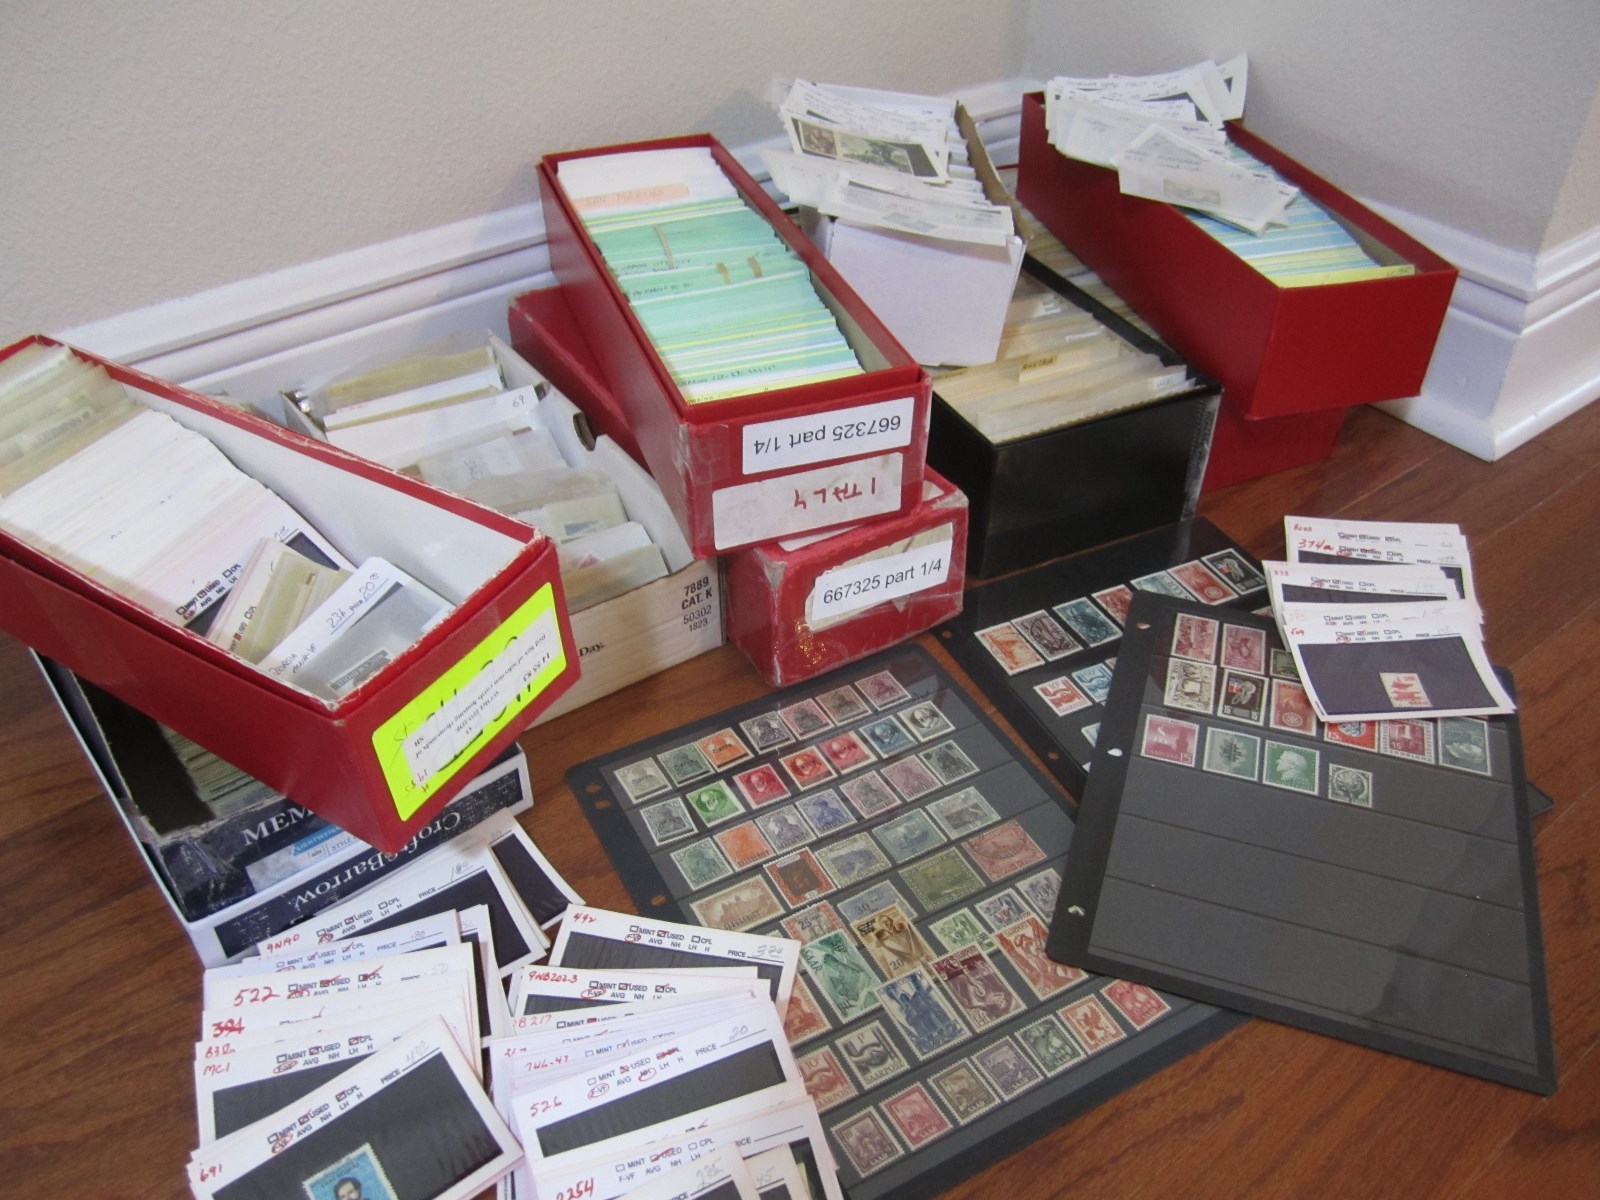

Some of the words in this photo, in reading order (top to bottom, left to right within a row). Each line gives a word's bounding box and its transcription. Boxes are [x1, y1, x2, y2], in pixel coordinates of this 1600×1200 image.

[788, 428, 826, 448] part
[832, 415, 901, 442] 667325
[753, 435, 782, 455] 1/4
[683, 576, 709, 596] 7889
[823, 574, 881, 604] 667325
[885, 566, 916, 590] part
[921, 558, 943, 577] 1/4
[681, 594, 703, 610] CAT.
[705, 587, 713, 599] K
[683, 605, 712, 625] 50302
[341, 924, 356, 935] AVG
[363, 916, 374, 925] NH
[418, 886, 437, 899] PRICE
[854, 902, 871, 915] 30
[326, 921, 344, 934] MINT
[354, 909, 373, 921] USED
[376, 941, 397, 951] PRICE
[639, 926, 656, 936] MINT
[666, 931, 685, 941] USED
[700, 937, 713, 946] CPL
[317, 949, 337, 959] USED
[648, 937, 664, 946] AVG
[670, 941, 682, 949] NH
[688, 943, 698, 951] LH
[704, 945, 711, 953] H
[727, 949, 747, 958] PRICE
[298, 982, 318, 991] MINT
[331, 977, 351, 986] USED
[599, 982, 617, 990] MINT
[628, 984, 648, 992] USED
[664, 986, 678, 994] CPL
[233, 985, 281, 1007] 522
[610, 991, 626, 999] AVG
[566, 1019, 586, 1027] MINT
[287, 1050, 307, 1060] MINT
[320, 1042, 341, 1052] USED
[302, 1057, 320, 1067] AVG
[328, 1051, 340, 1060] NH
[348, 1047, 359, 1055] LH
[595, 1046, 613, 1055] MINT
[598, 1069, 616, 1082] MINT
[630, 1056, 651, 1069] USED
[615, 1075, 633, 1087] AVG
[659, 1061, 671, 1072] LH
[677, 1056, 685, 1065] H
[694, 1043, 718, 1057] PRICE
[278, 1122, 298, 1138] MINT
[309, 1103, 330, 1119] USED
[345, 1084, 361, 1097] CPL
[296, 1125, 313, 1139] AVG
[319, 1112, 333, 1123] NH
[338, 1101, 350, 1111] LH
[356, 1091, 364, 1101] H
[380, 1067, 401, 1084] PRICE
[529, 1095, 563, 1117] 526
[626, 1157, 646, 1169] MINT
[661, 1146, 683, 1158] USED
[699, 1137, 714, 1147] CPL
[618, 1171, 636, 1183] F-VF
[645, 1164, 662, 1176] AVG
[670, 1158, 682, 1168] NH
